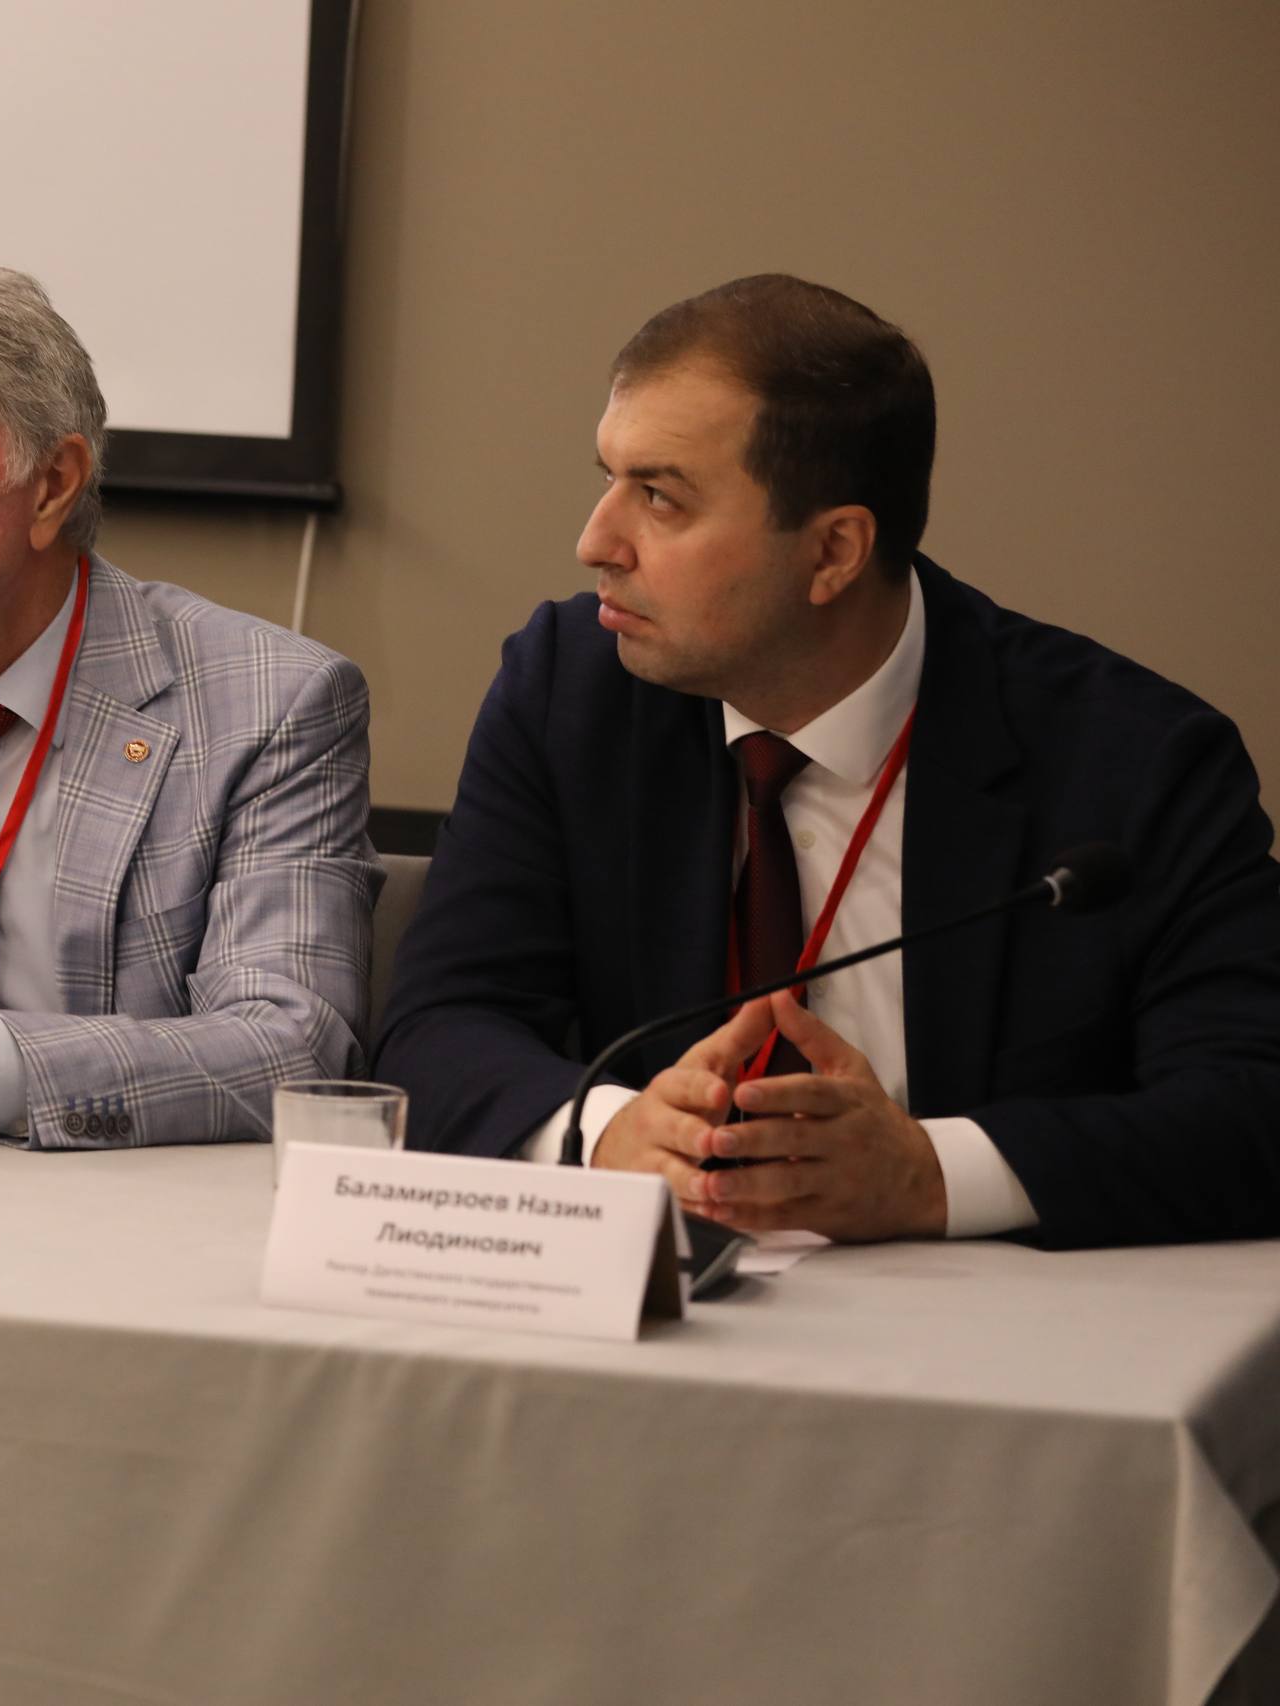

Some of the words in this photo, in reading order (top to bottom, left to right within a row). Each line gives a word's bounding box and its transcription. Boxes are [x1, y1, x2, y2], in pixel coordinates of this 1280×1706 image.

[335, 1175, 509, 1212] Баламирзоев
[517, 1192, 602, 1220] Назим
[375, 1221, 542, 1258] Лиодинович
